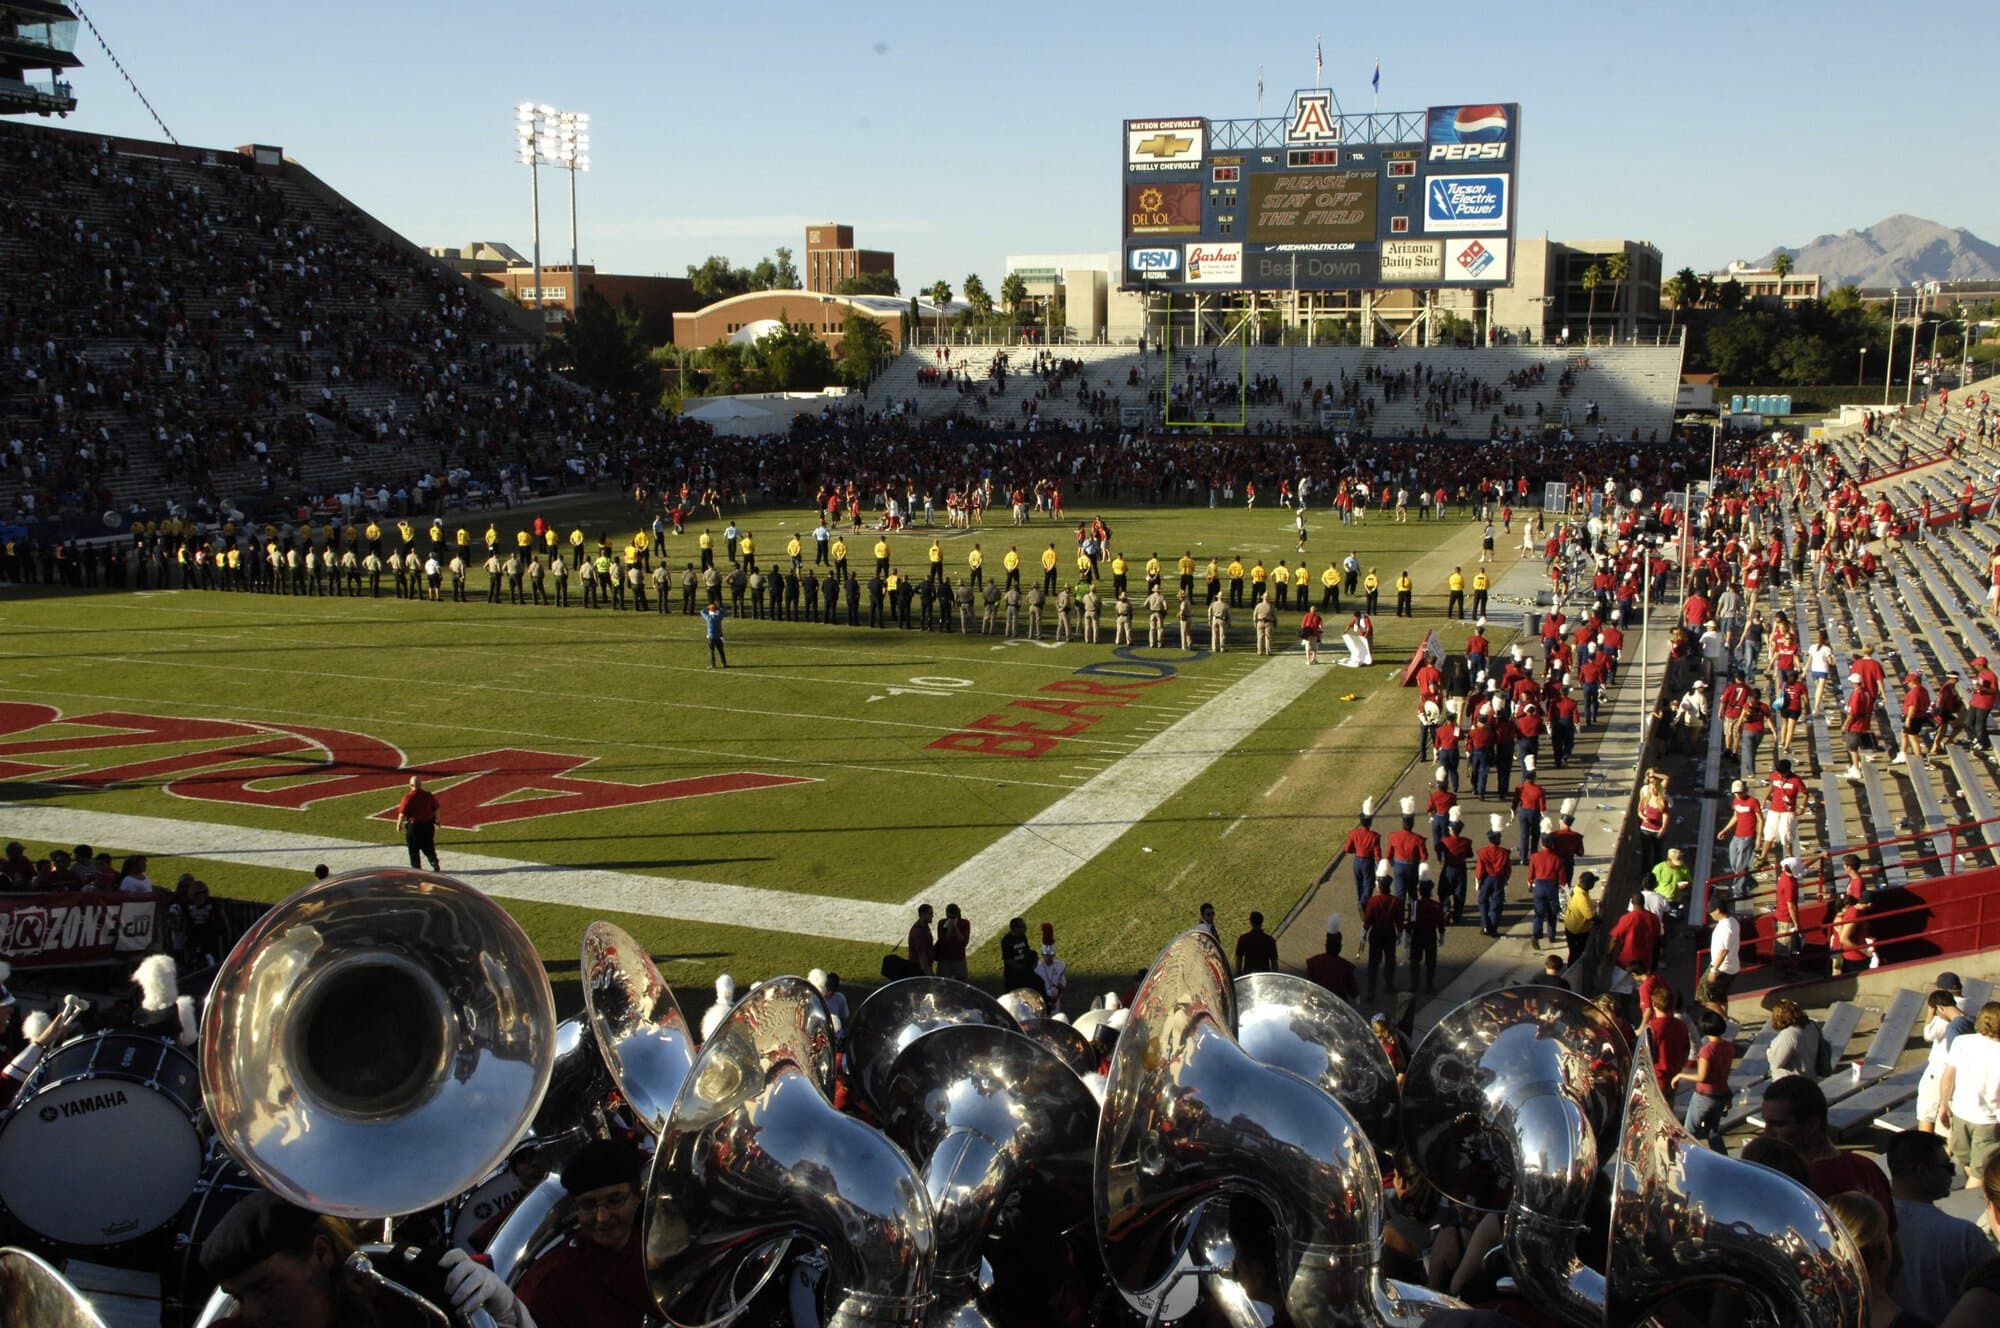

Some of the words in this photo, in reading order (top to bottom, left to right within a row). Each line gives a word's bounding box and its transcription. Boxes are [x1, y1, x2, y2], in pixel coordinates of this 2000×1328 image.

[1130, 121, 1159, 130] WATSON
[1160, 119, 1200, 128] CHEVROLET
[1287, 93, 1339, 144] A
[1429, 142, 1507, 161] PEPSI
[1160, 161, 1200, 170] CHEVROLET
[1274, 175, 1347, 191] PLEASE
[1447, 183, 1487, 194] Tucson
[1261, 193, 1311, 208] STAY
[1315, 192, 1362, 207] OFF
[1451, 193, 1496, 204] Electric
[1258, 211, 1299, 226] THE
[1303, 210, 1364, 225] FIELD
[1455, 205, 1496, 215] Power
[1132, 214, 1148, 225] DEL
[1152, 213, 1170, 225] SOL
[1388, 242, 1433, 254] Arizona
[1137, 251, 1173, 268] FSN
[1381, 256, 1412, 269] Daily
[1414, 255, 1440, 267] Star
[1260, 259, 1302, 277] Bear
[1308, 259, 1360, 277] Down
[1736, 687, 1743, 701] 7
[922, 674, 1178, 759] BEAR
[46, 904, 120, 951] ZONE
[60, 1090, 128, 1118] YAMAHA
